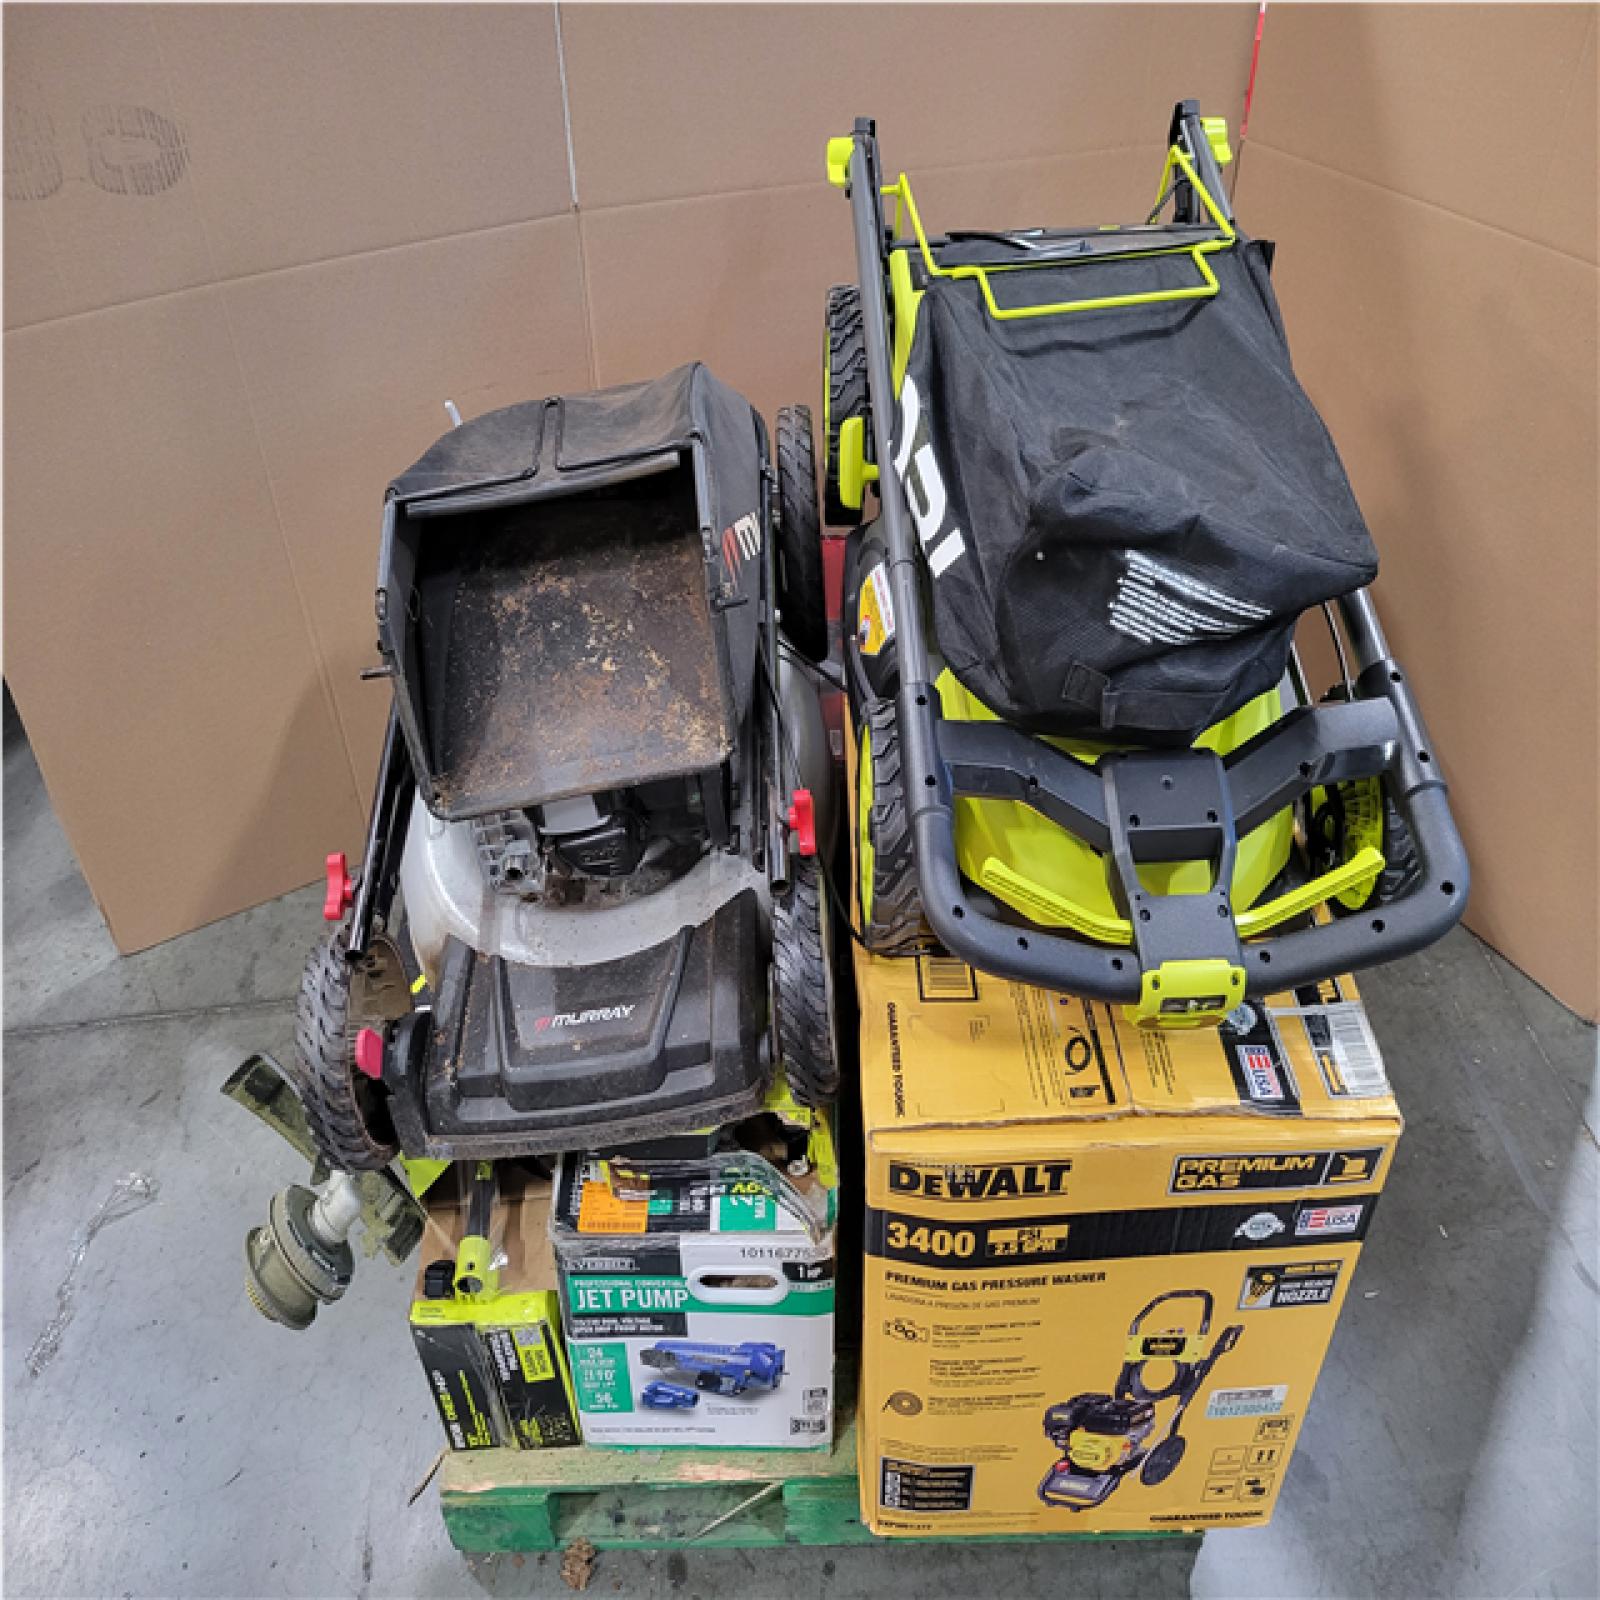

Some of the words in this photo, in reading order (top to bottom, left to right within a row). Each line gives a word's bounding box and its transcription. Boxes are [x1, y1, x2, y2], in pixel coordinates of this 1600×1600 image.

[552, 1004, 635, 1029] MURRAY
[1177, 1155, 1316, 1175] PREMIUM
[890, 1163, 1071, 1198] DEWALT
[1175, 1175, 1240, 1190] GAS
[1324, 1212, 1356, 1227] USA
[889, 1220, 977, 1258] 3400
[885, 1270, 948, 1290] PREMIUM
[952, 1279, 978, 1291] GAS
[981, 1274, 1048, 1291] PRESSURE
[1052, 1271, 1106, 1286] WASHER
[577, 1290, 613, 1309] JET
[620, 1289, 688, 1309] PUMP
